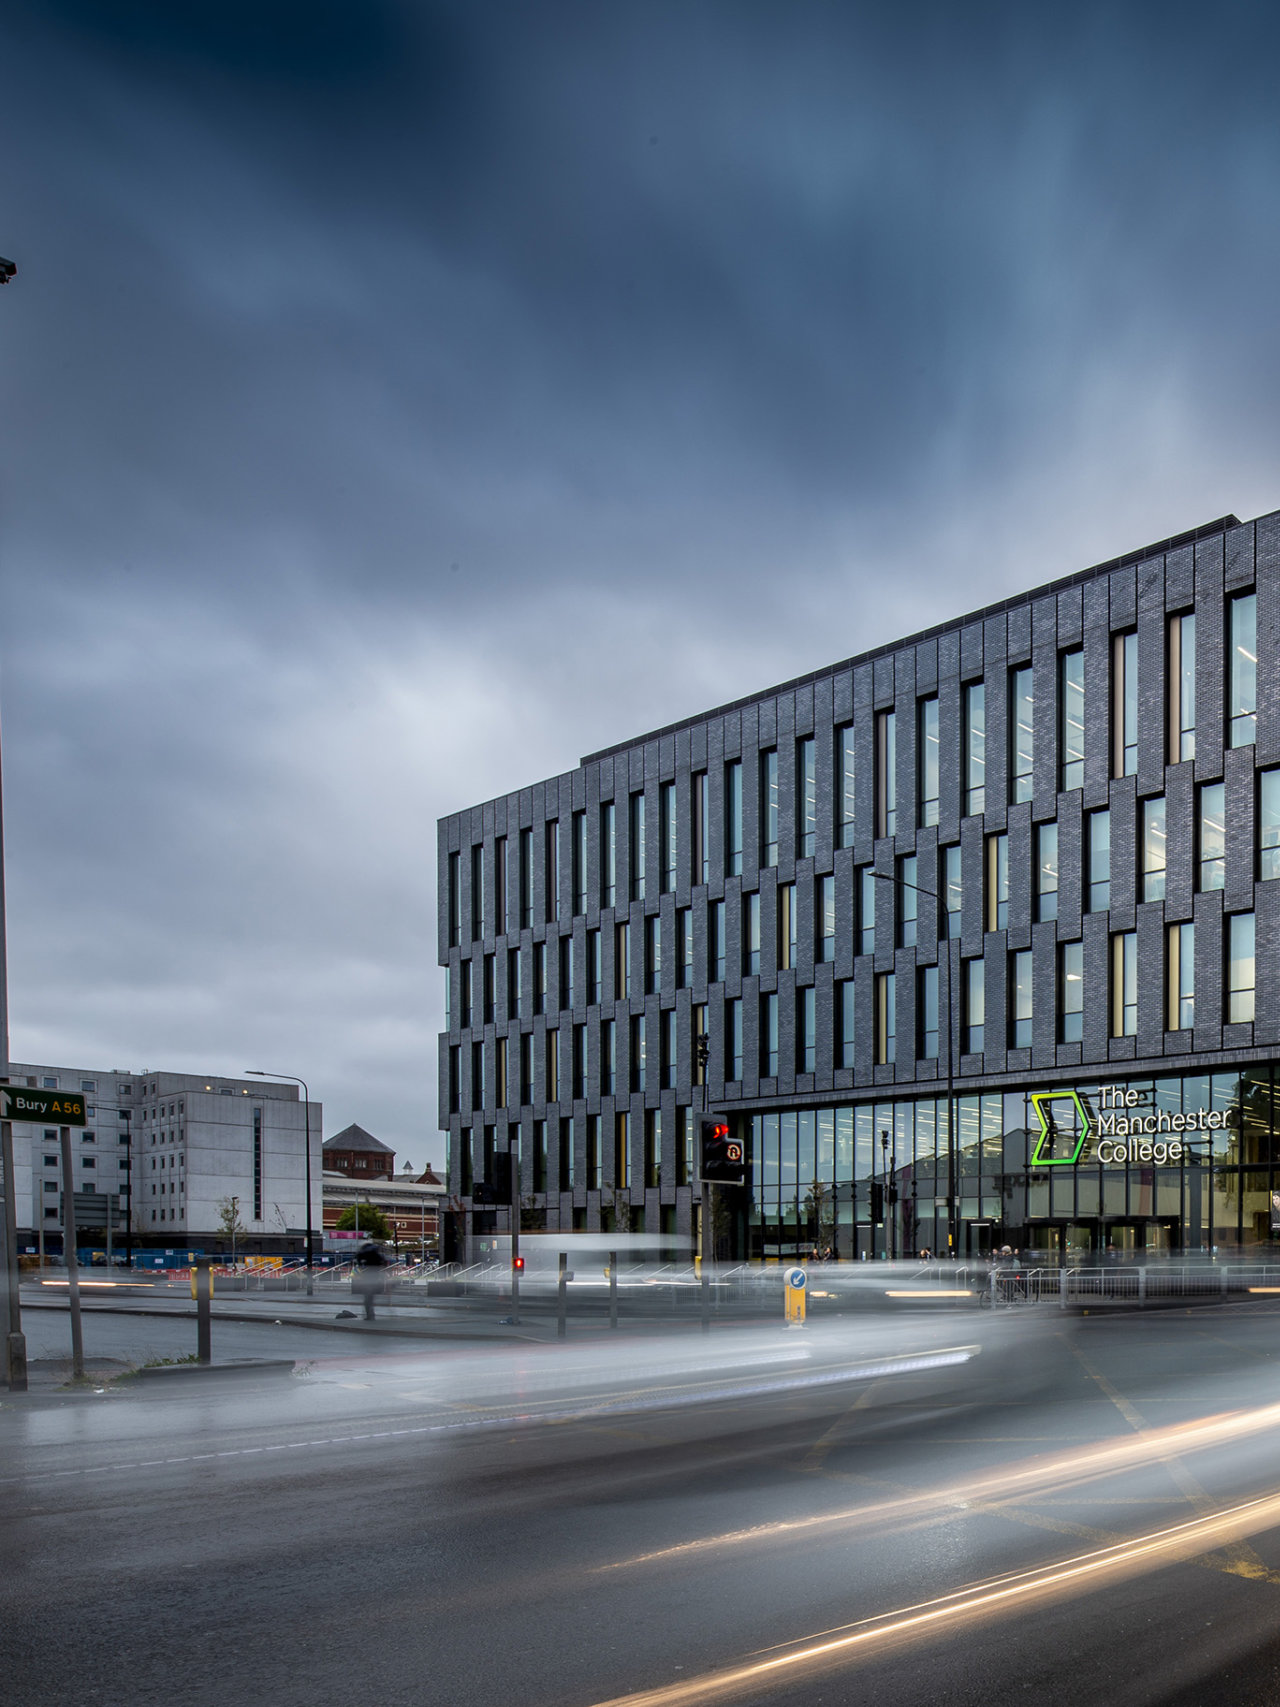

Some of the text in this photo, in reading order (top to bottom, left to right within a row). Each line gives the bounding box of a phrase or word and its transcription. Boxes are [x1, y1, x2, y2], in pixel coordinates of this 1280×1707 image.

[16, 1097, 47, 1113] Bury
[1098, 1085, 1138, 1108] The
[1098, 1107, 1232, 1136] Manchester
[1098, 1138, 1183, 1165] College
